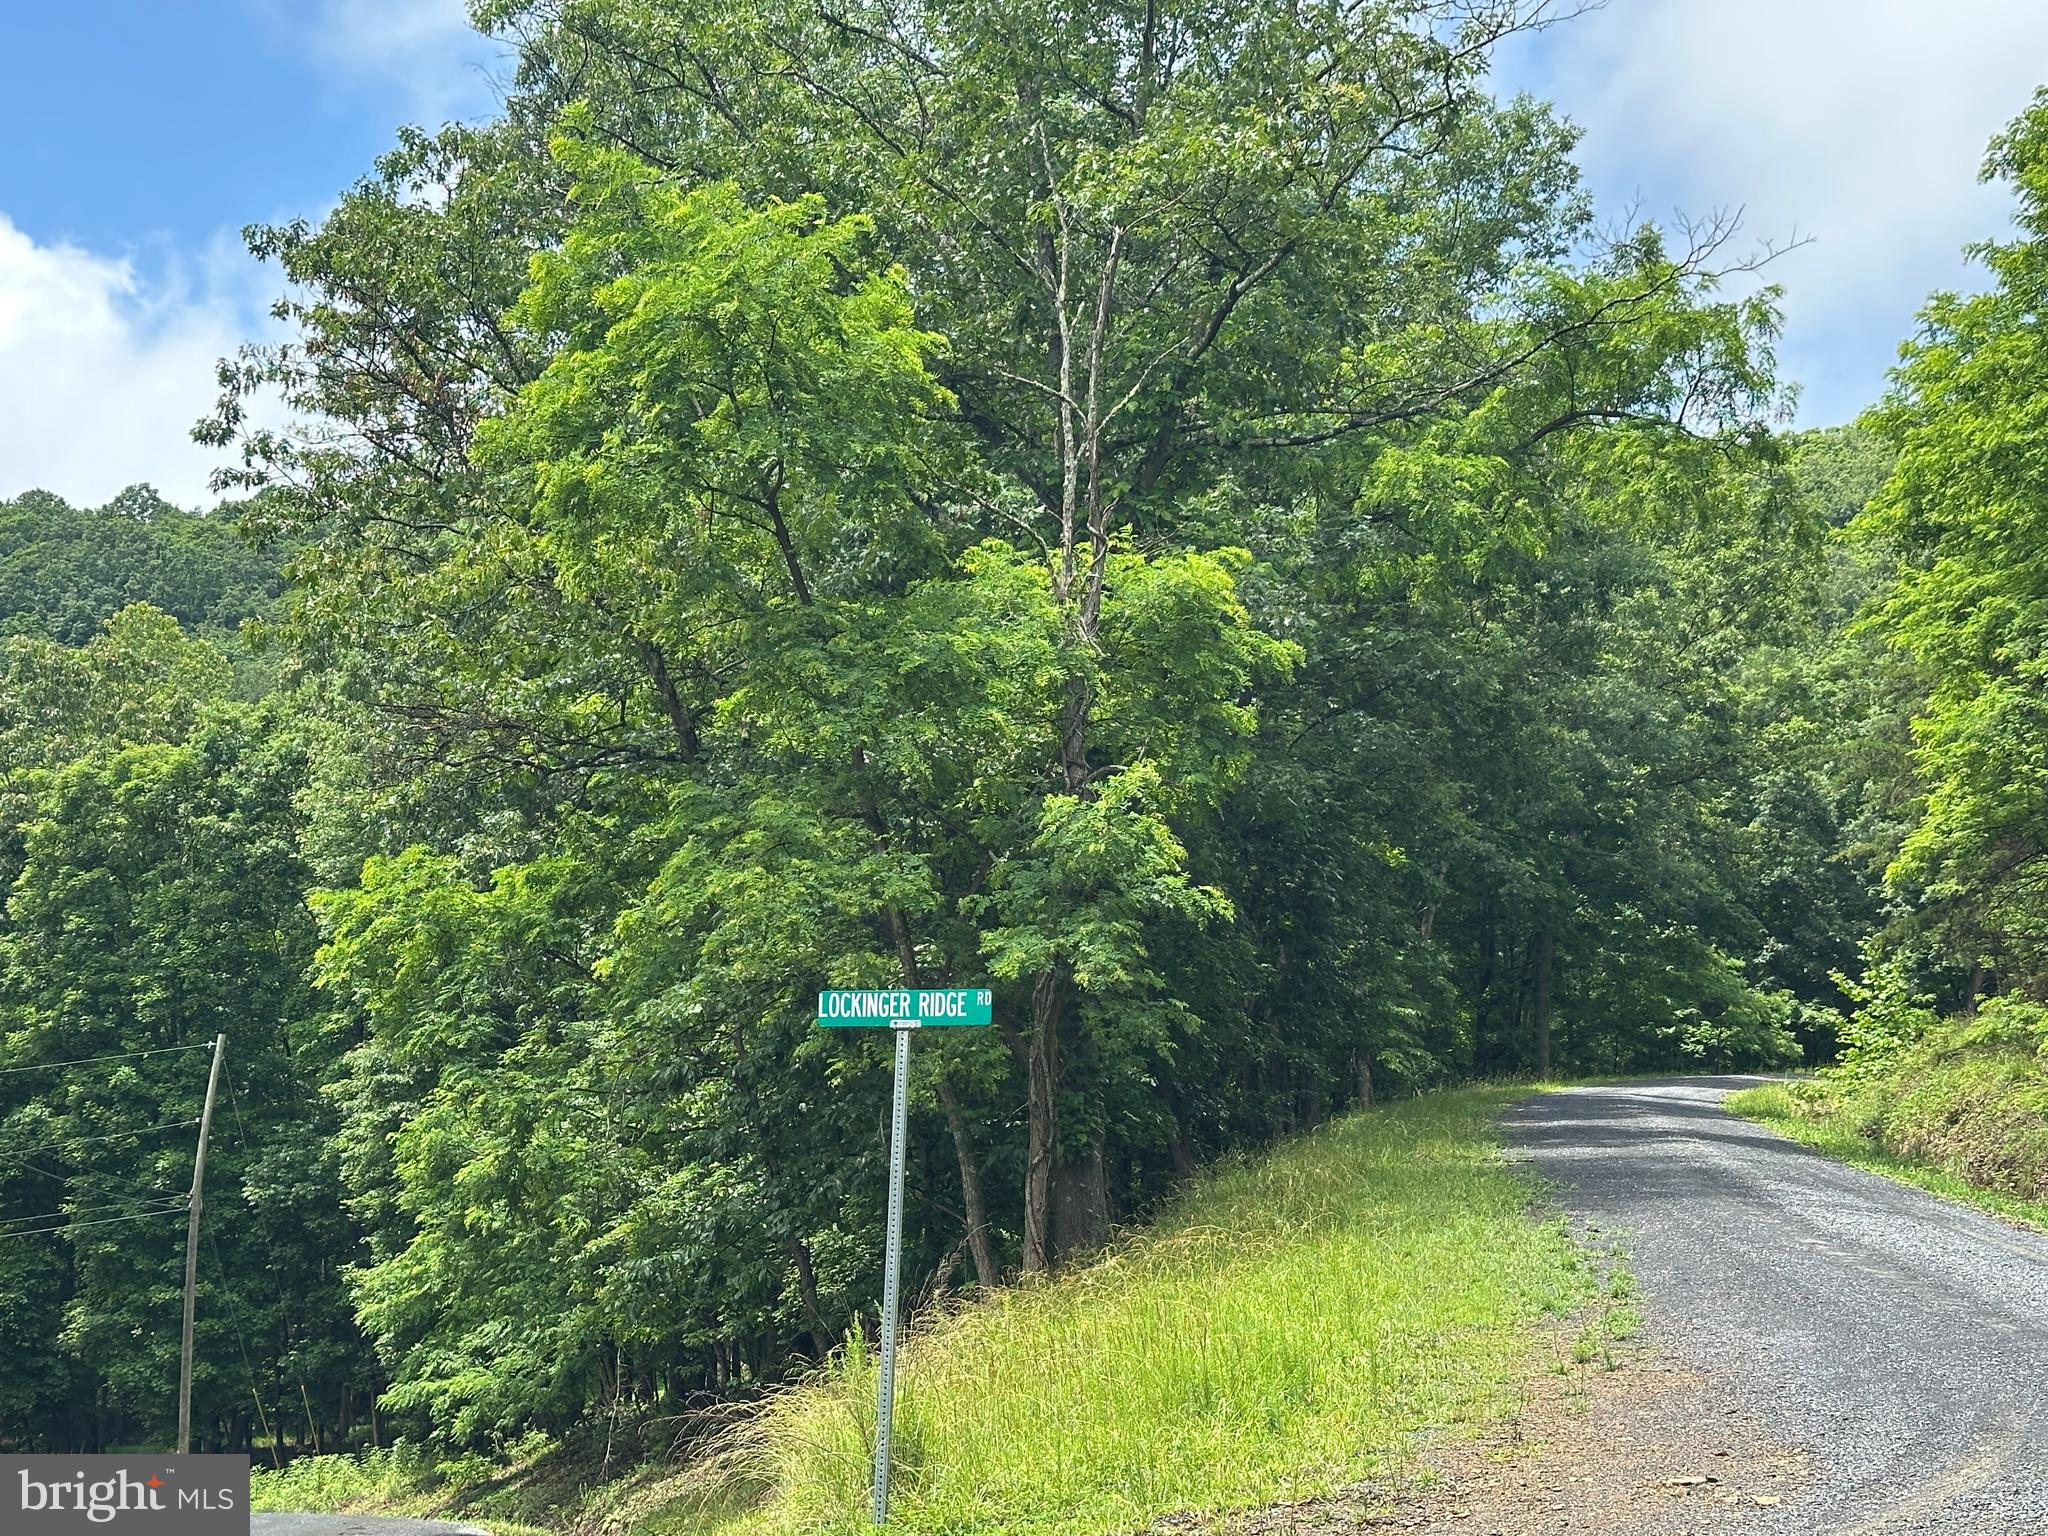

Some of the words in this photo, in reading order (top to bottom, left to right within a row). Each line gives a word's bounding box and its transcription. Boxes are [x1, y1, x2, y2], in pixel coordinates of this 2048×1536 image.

[818, 992, 910, 1018] LOCKINGER
[919, 991, 967, 1017] RIDGE
[977, 991, 992, 1006] RD
